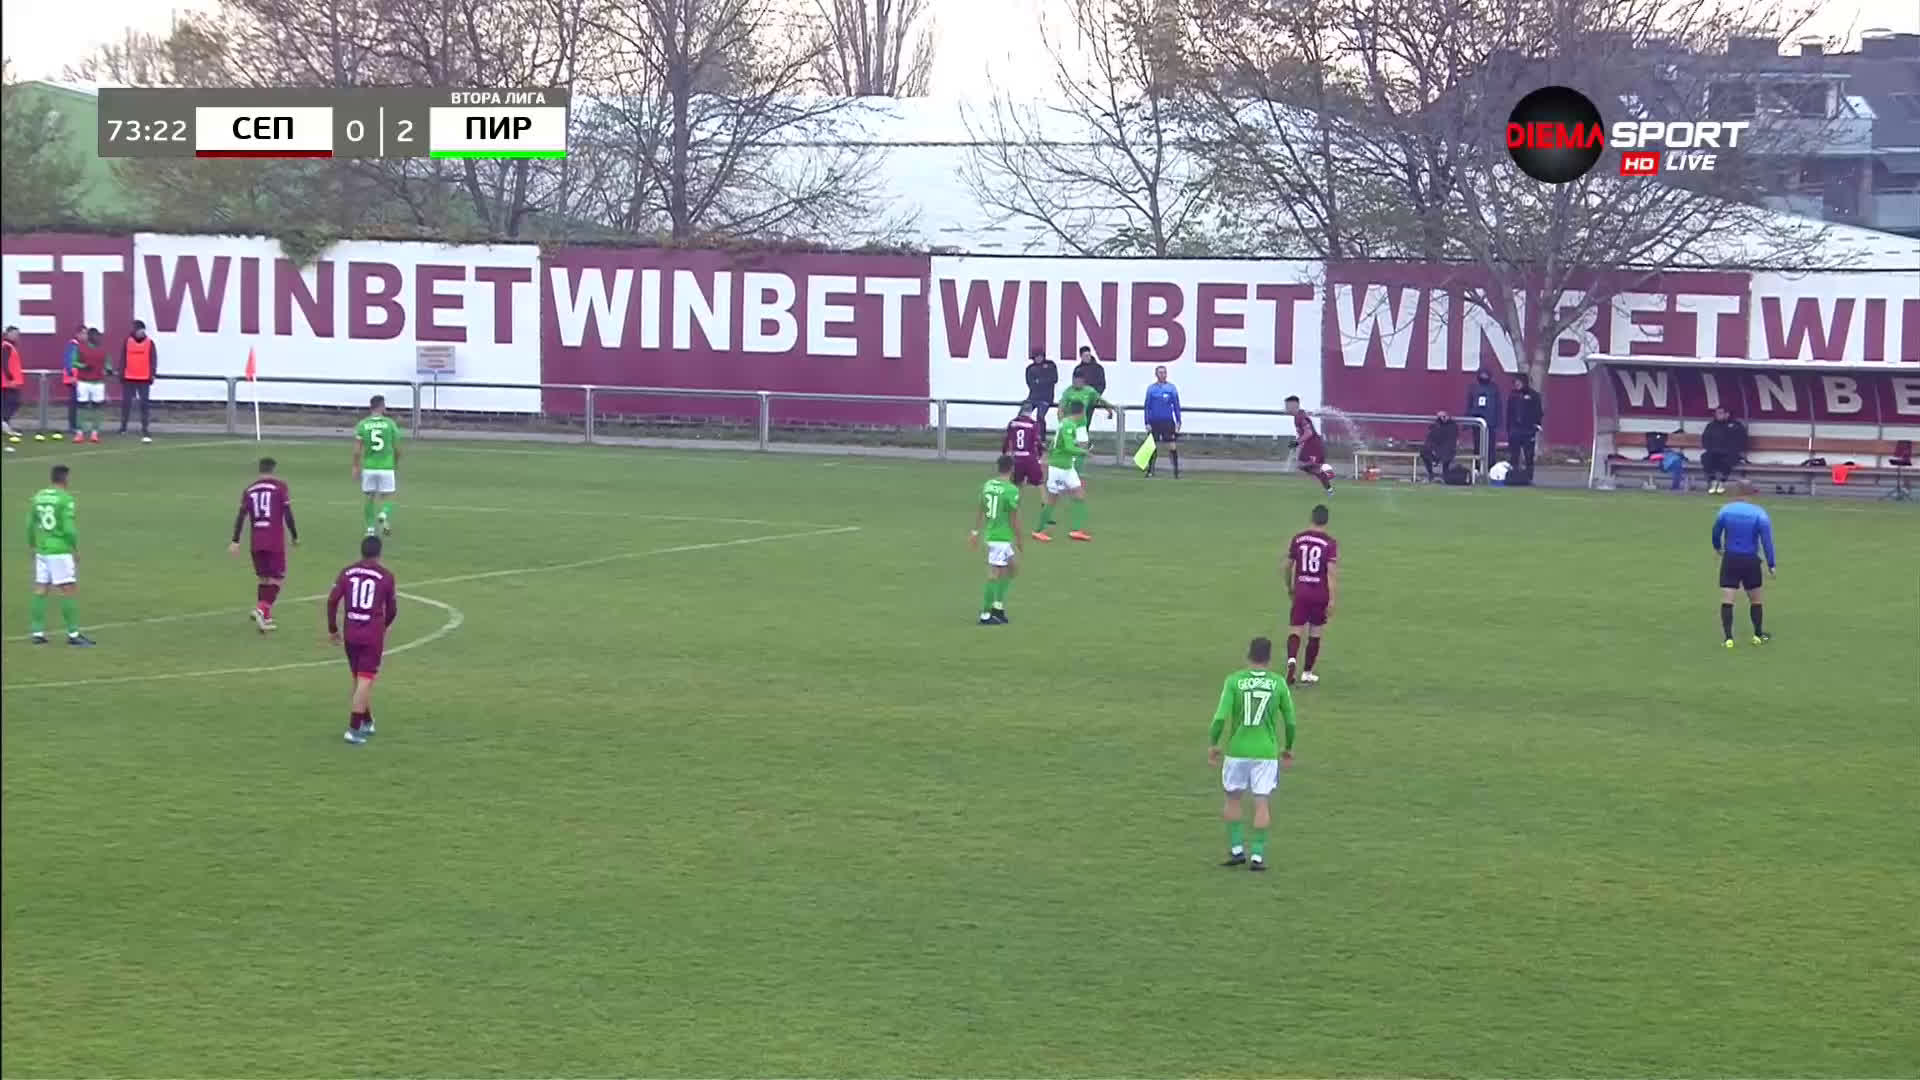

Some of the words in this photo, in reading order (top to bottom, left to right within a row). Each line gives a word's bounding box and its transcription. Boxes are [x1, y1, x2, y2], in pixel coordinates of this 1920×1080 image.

[143, 254, 532, 344] WINBET
[549, 266, 922, 358] WINBET
[938, 278, 1315, 365] WINBET
[1334, 283, 1741, 375] WINBET
[1761, 297, 1920, 361] WI
[371, 430, 384, 451] 5
[1016, 429, 1025, 450] 8
[250, 491, 271, 518] 14
[985, 494, 998, 519] 31
[1300, 545, 1321, 572] 18
[349, 577, 376, 609] 10
[1243, 691, 1272, 726] 17
